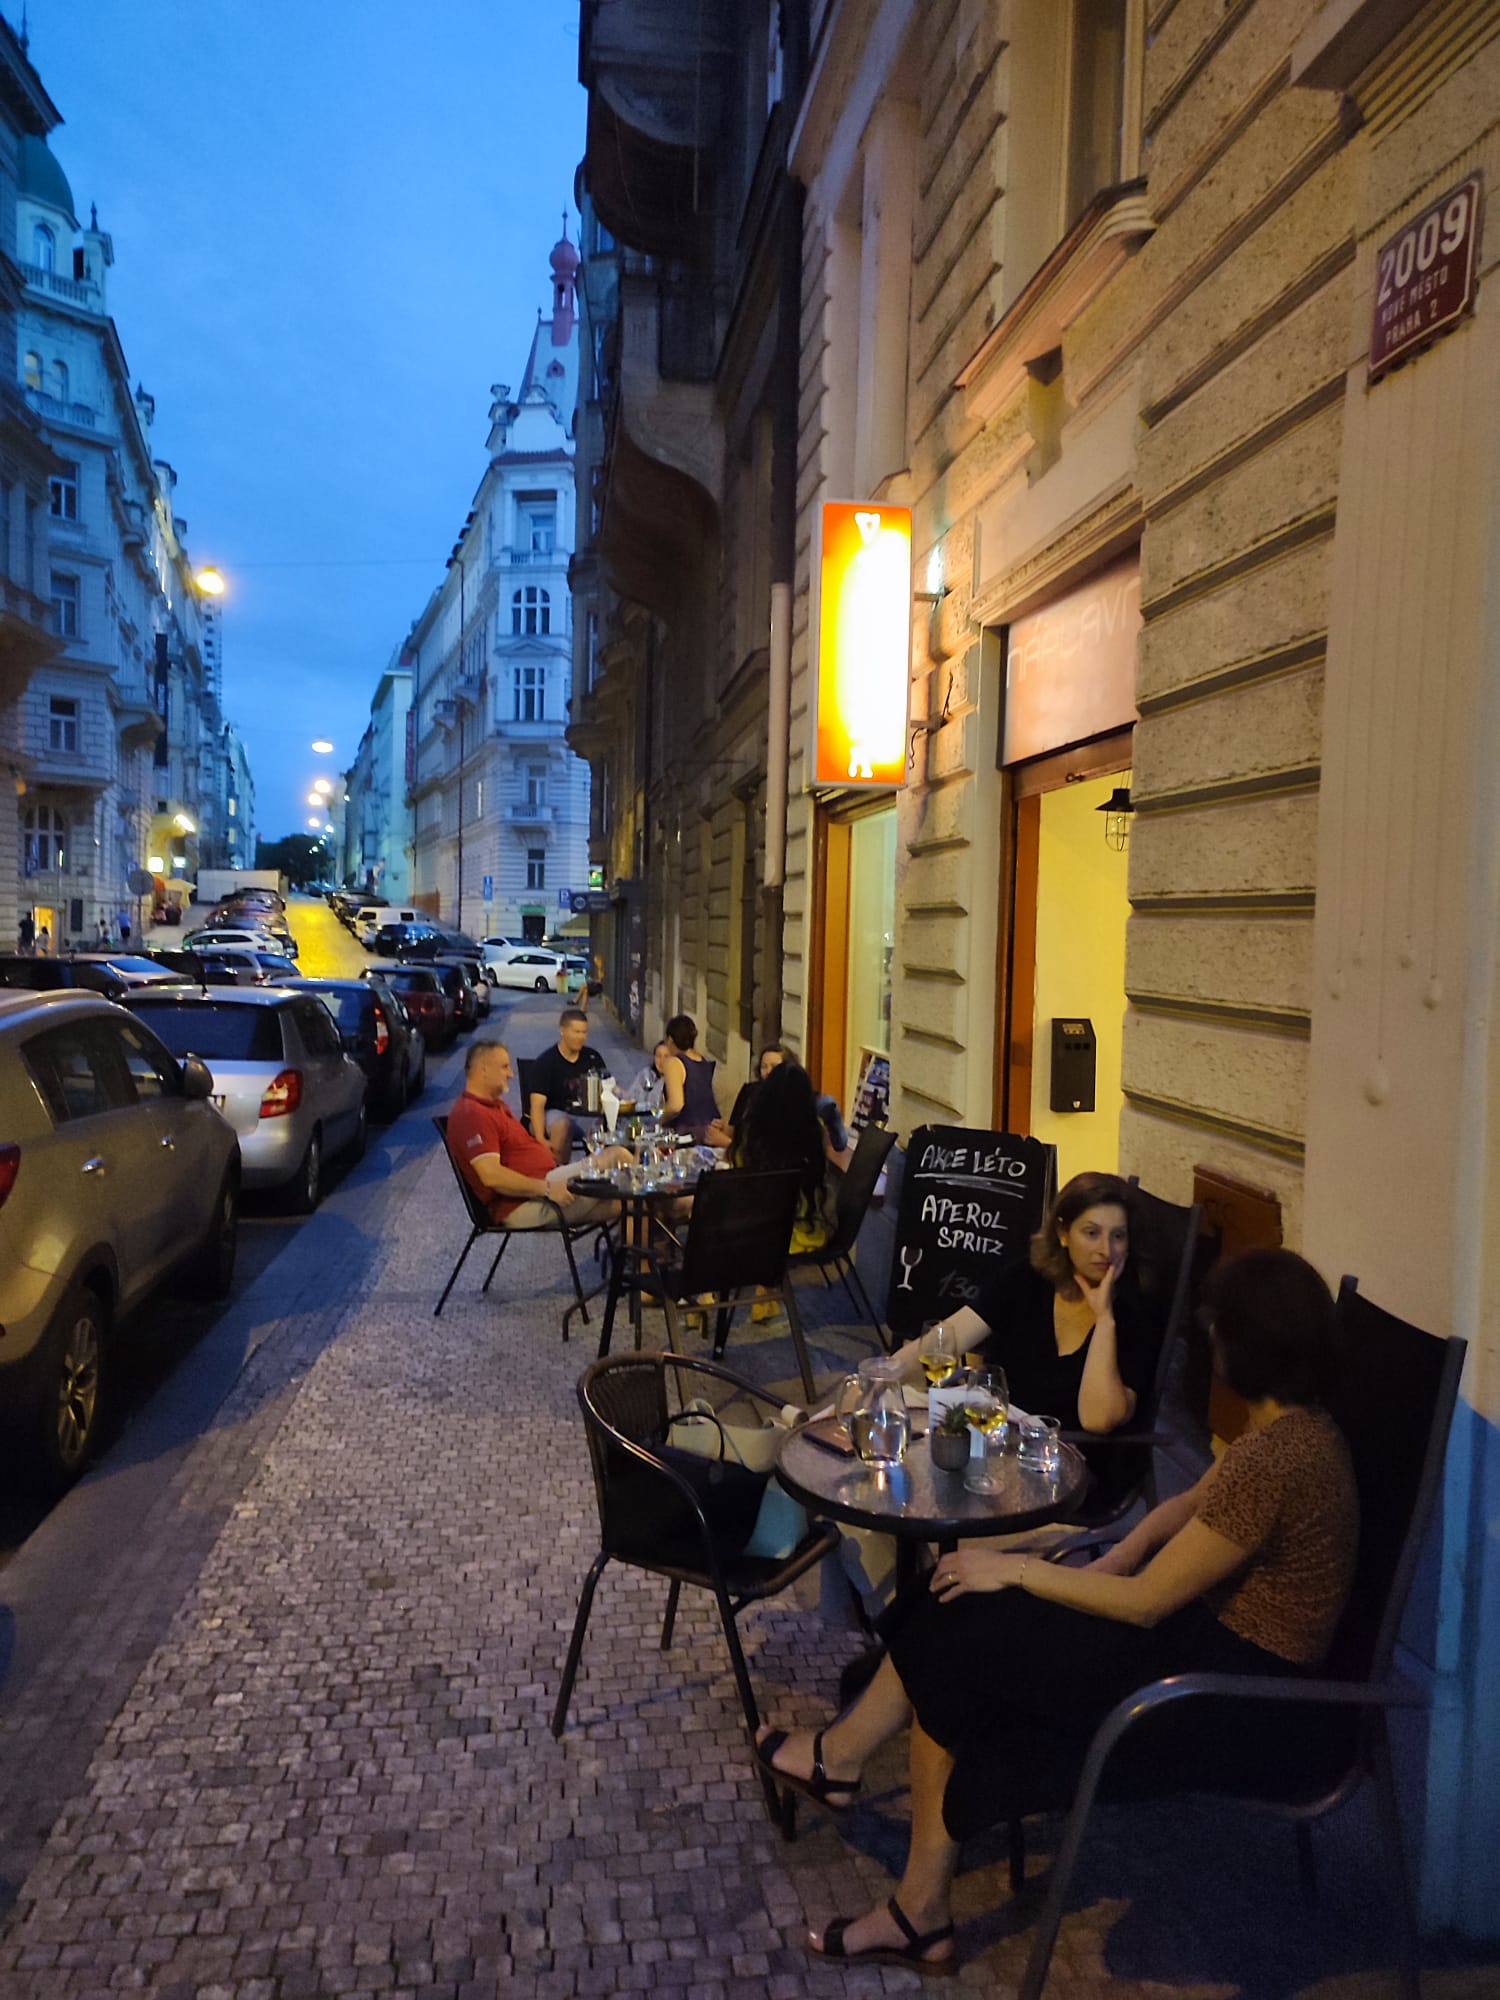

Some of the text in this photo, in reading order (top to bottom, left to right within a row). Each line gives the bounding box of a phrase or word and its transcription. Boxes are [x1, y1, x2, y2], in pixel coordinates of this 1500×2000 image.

[1377, 193, 1469, 307] 2009
[1385, 298, 1438, 349] PRAHA 2
[972, 1147, 1026, 1177] LÉTO
[921, 1194, 1008, 1230] APEROL
[937, 1226, 1004, 1255] SPRITZ
